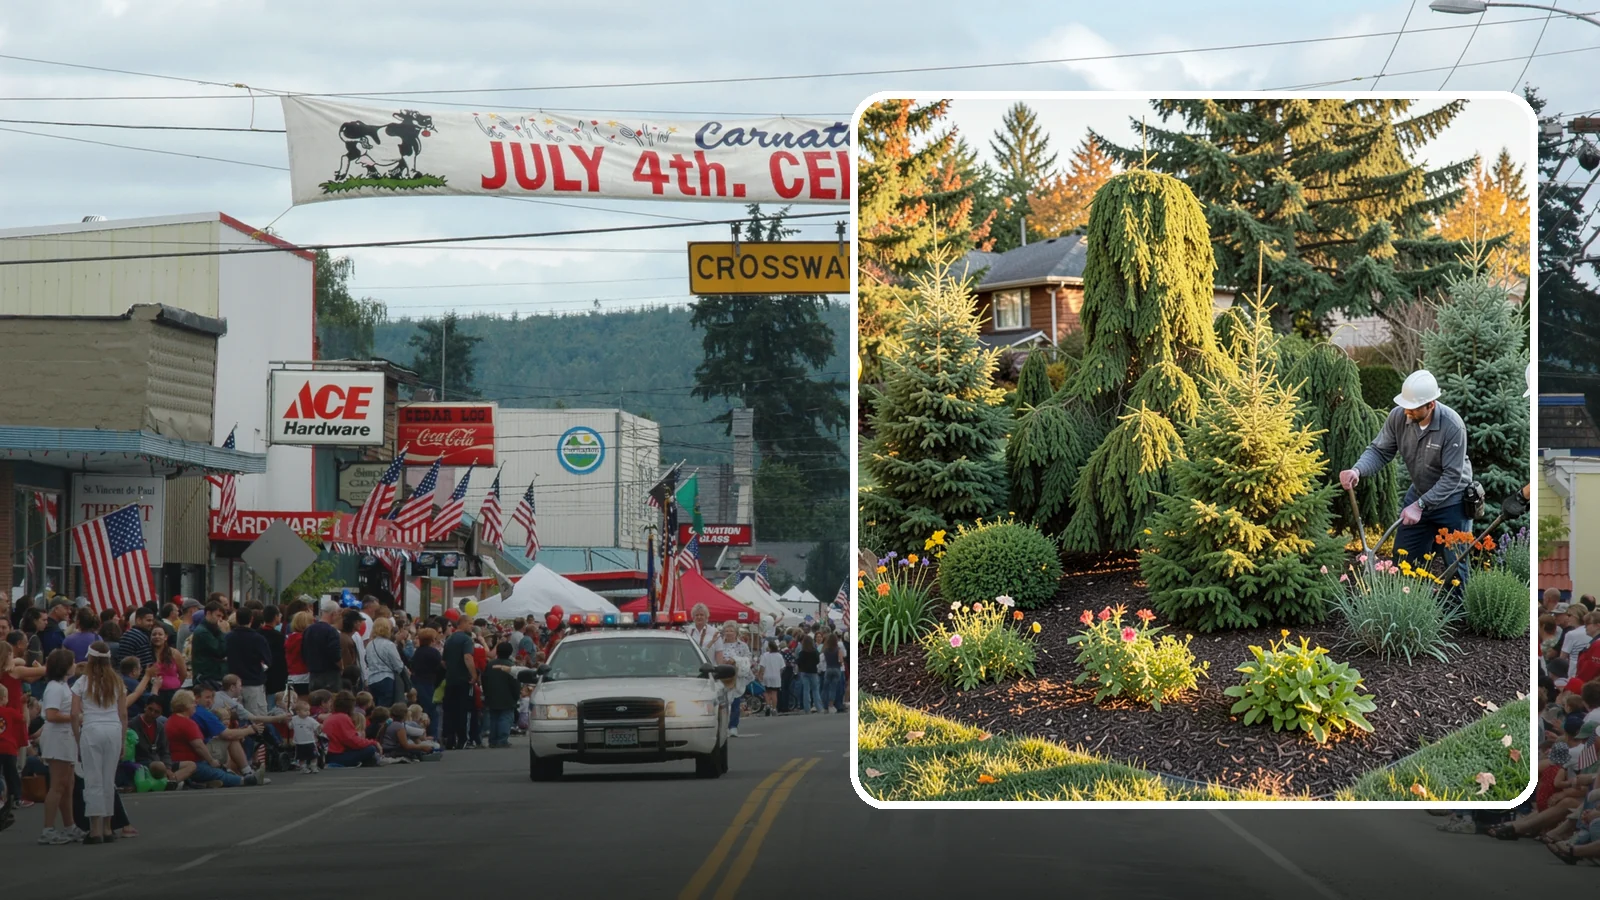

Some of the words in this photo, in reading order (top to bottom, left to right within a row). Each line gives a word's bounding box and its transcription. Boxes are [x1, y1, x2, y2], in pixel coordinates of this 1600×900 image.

[695, 121, 850, 149] Carnat
[481, 141, 605, 193] JULY
[632, 151, 747, 197] 4th.
[697, 254, 850, 279] CROSSWA
[283, 380, 373, 420] ACE
[405, 409, 452, 422] CEDAR
[284, 421, 370, 436] Hardware
[353, 467, 387, 480] Simpl
[96, 485, 124, 495] Vincent
[126, 485, 136, 494] de
[138, 486, 155, 495] Paul
[81, 503, 153, 522] THT
[688, 526, 741, 534] CRNATION
[699, 535, 730, 543] GLASS
